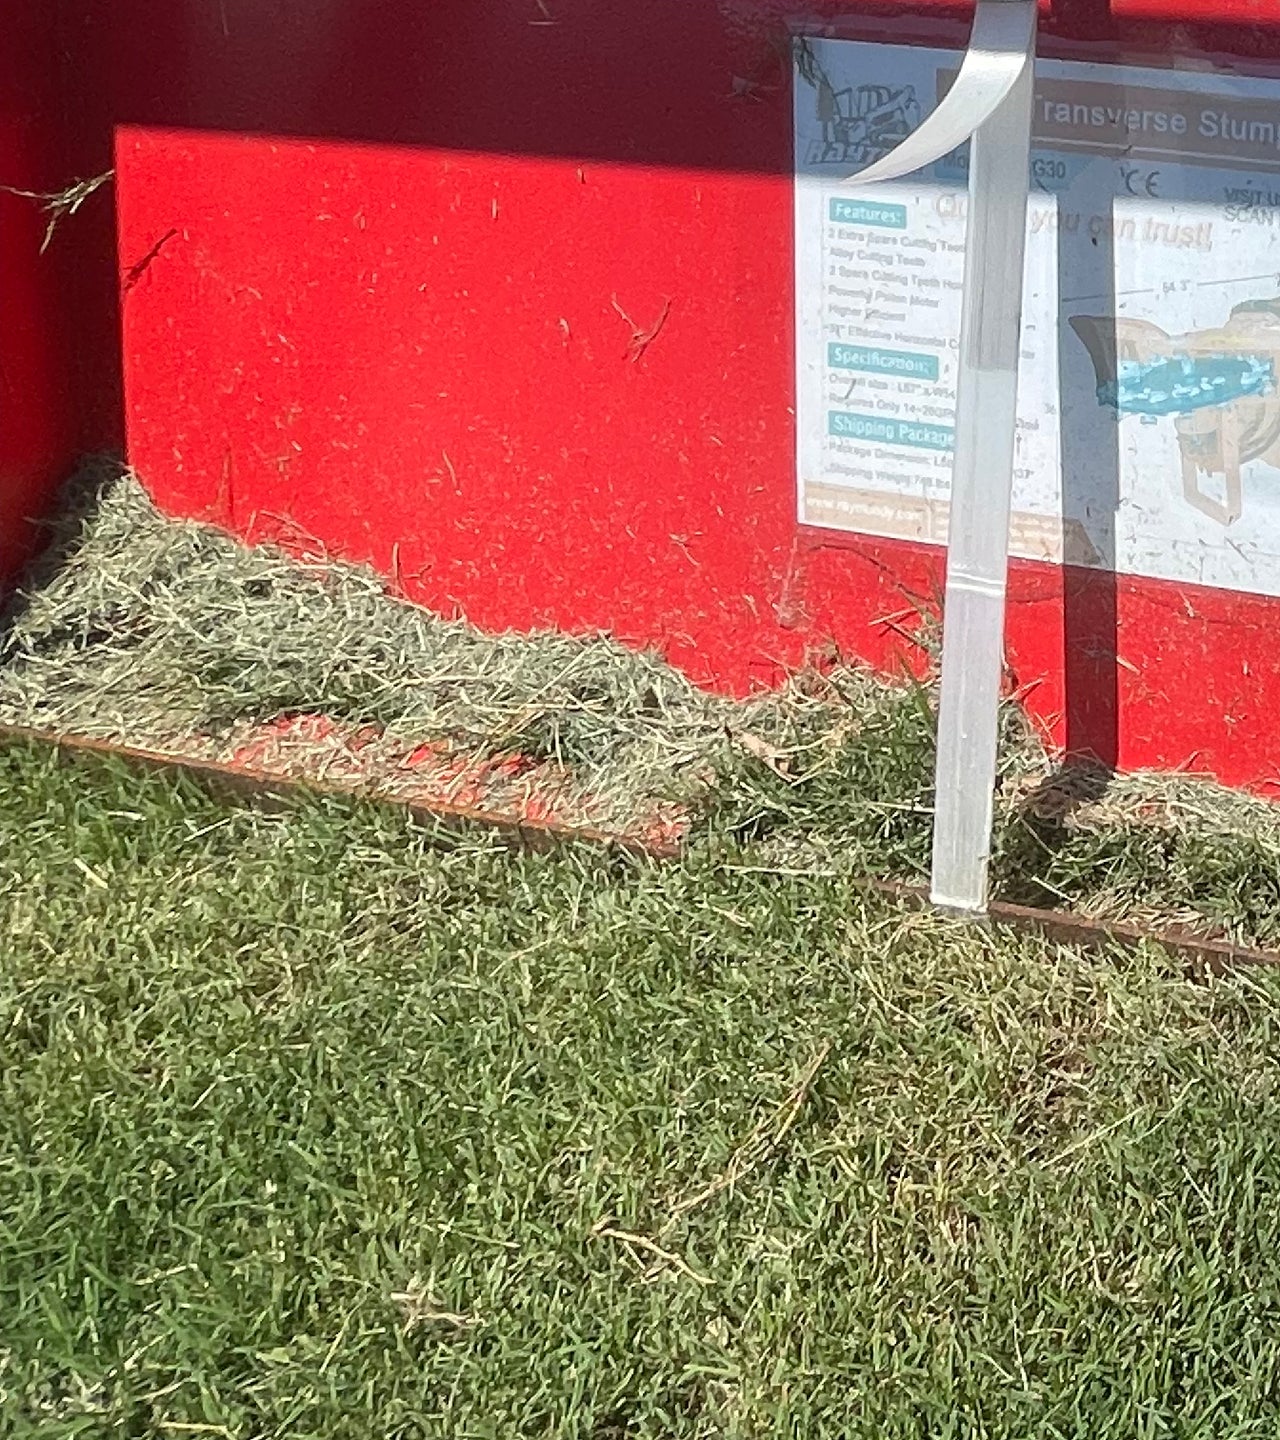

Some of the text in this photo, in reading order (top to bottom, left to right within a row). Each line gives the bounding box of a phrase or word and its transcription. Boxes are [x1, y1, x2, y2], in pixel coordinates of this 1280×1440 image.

[1035, 95, 1188, 135] ransverse
[1224, 186, 1263, 206] VISIT
[833, 202, 902, 223] Features:
[1223, 203, 1276, 227] SCAN
[834, 415, 896, 439] Shipping
